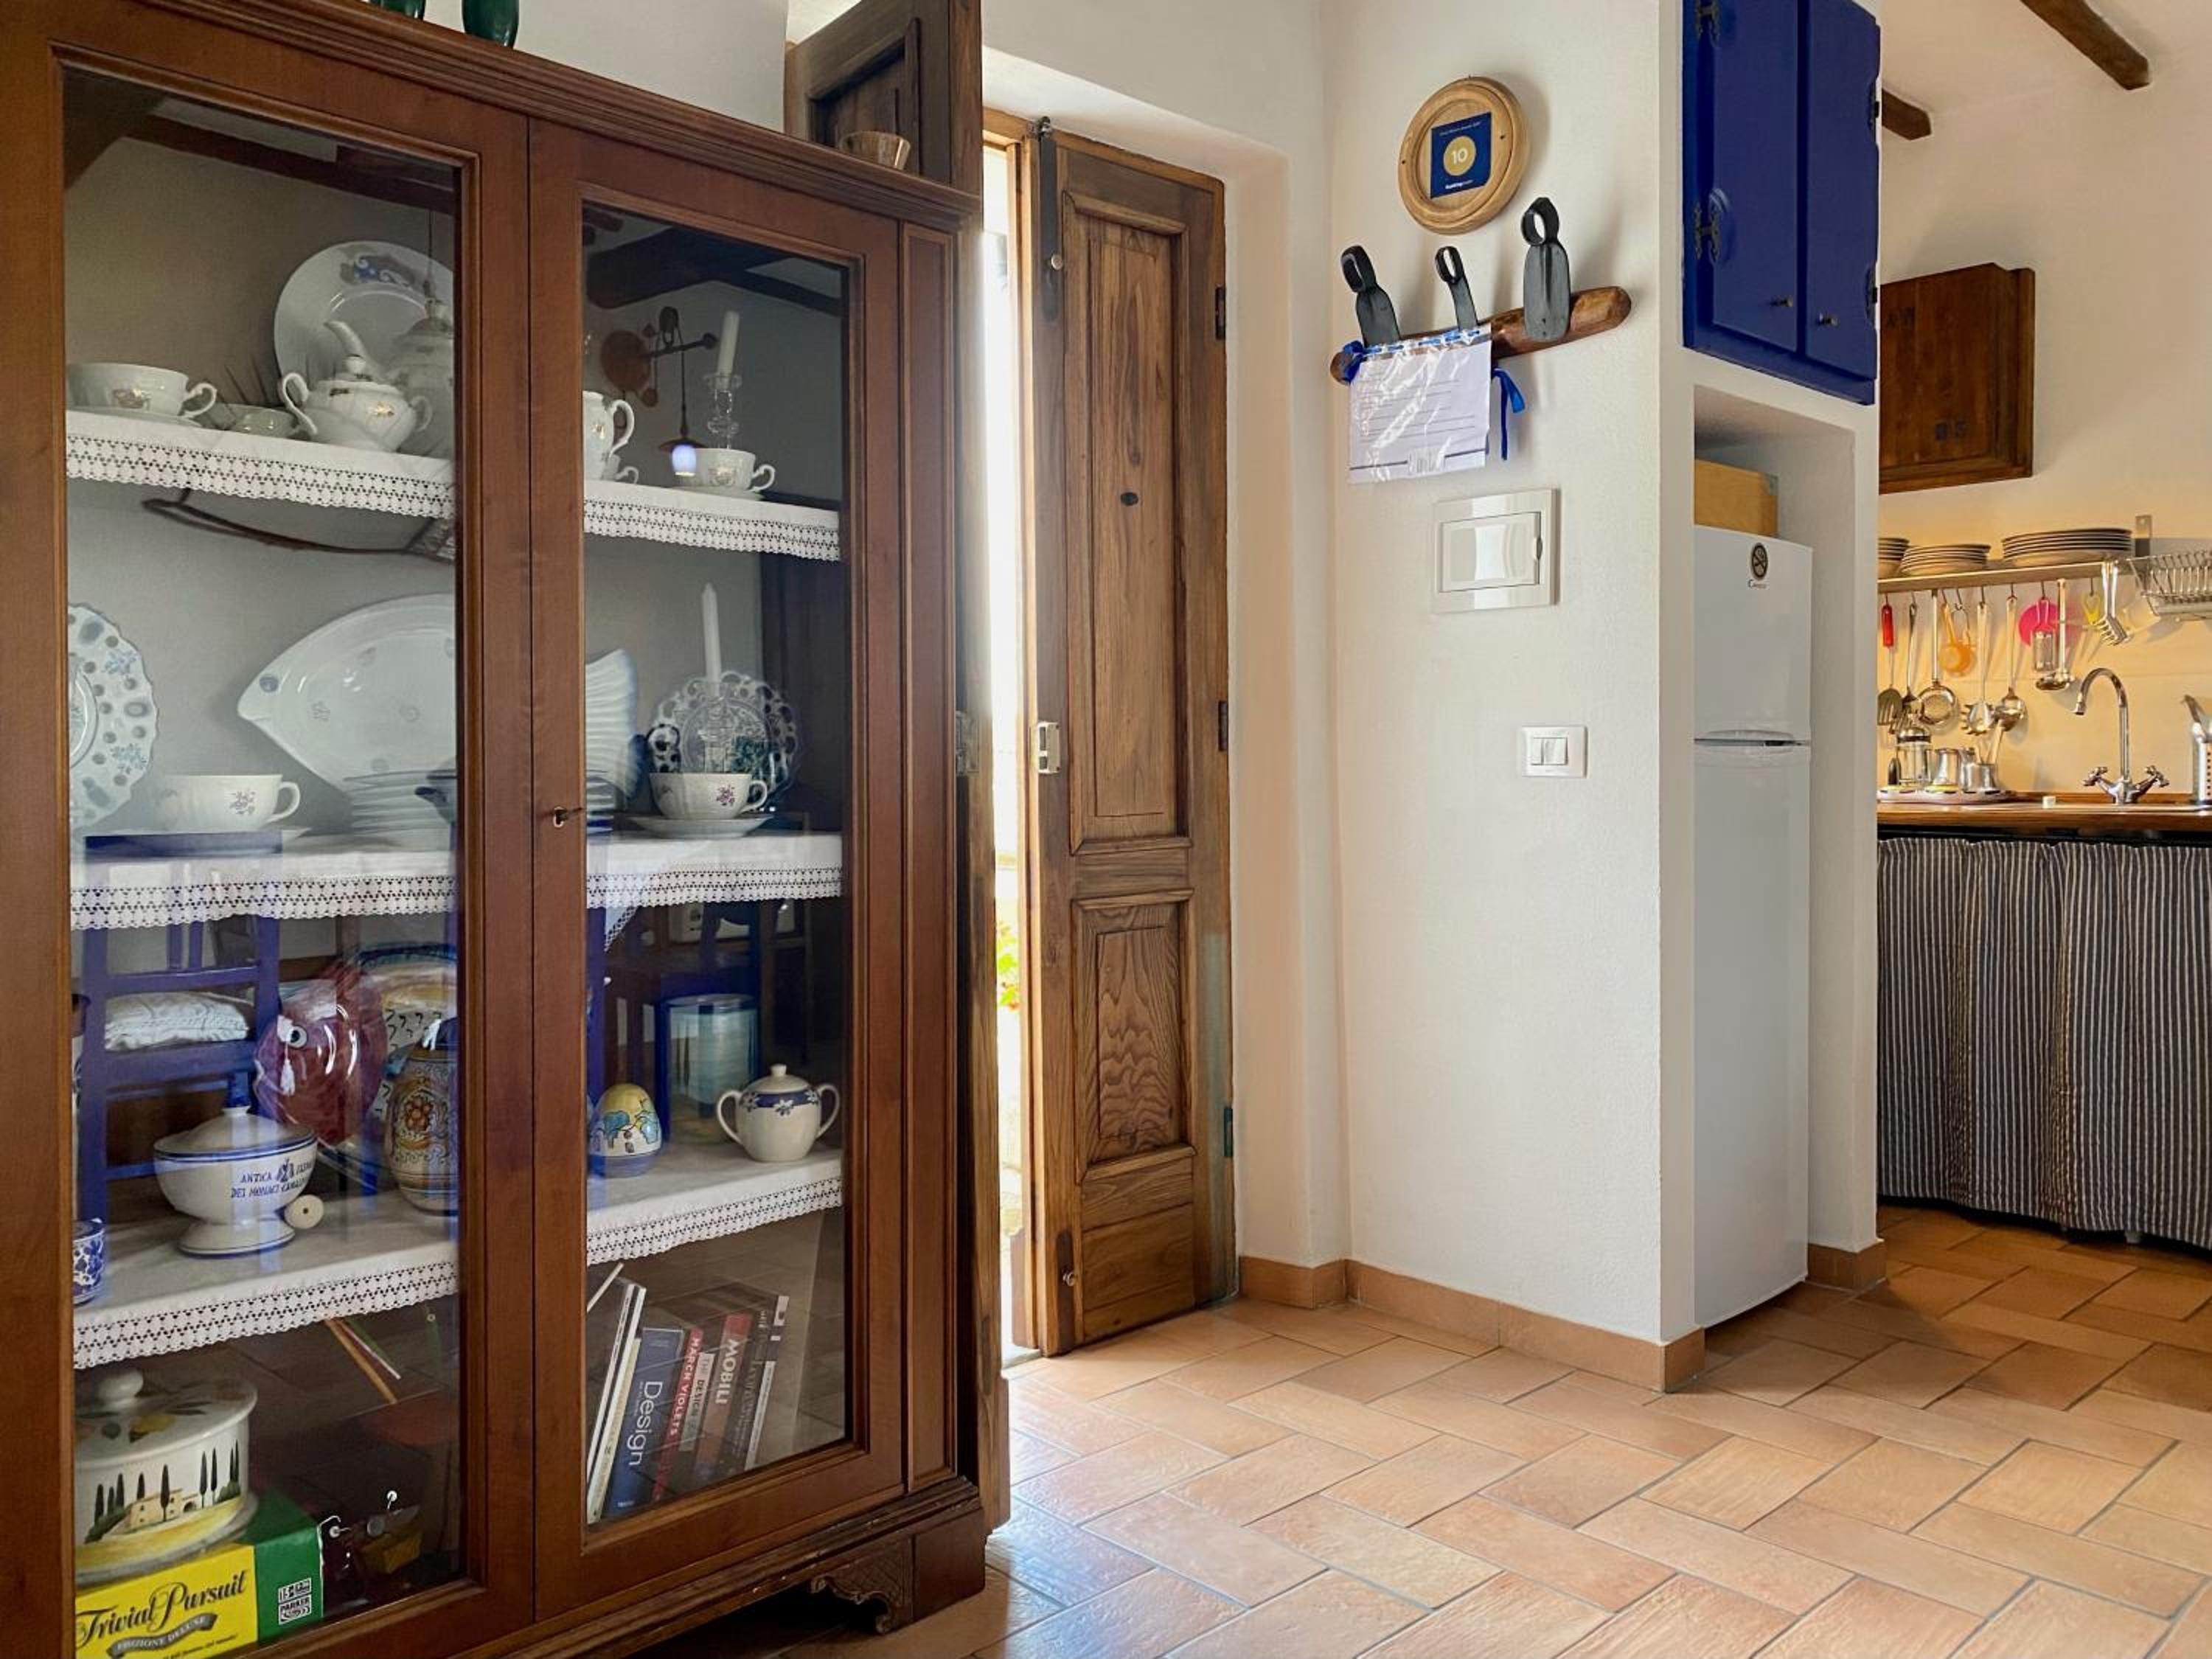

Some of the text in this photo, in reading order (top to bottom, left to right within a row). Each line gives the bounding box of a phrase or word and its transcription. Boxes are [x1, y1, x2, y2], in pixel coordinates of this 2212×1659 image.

[1451, 148, 1468, 164] 10
[670, 1338, 701, 1436] MARCH VIOLETS
[715, 1338, 740, 1405] MOBILI
[627, 1381, 664, 1466] Design
[76, 1596, 156, 1649] Trivial
[149, 1570, 248, 1632] Pursuit
